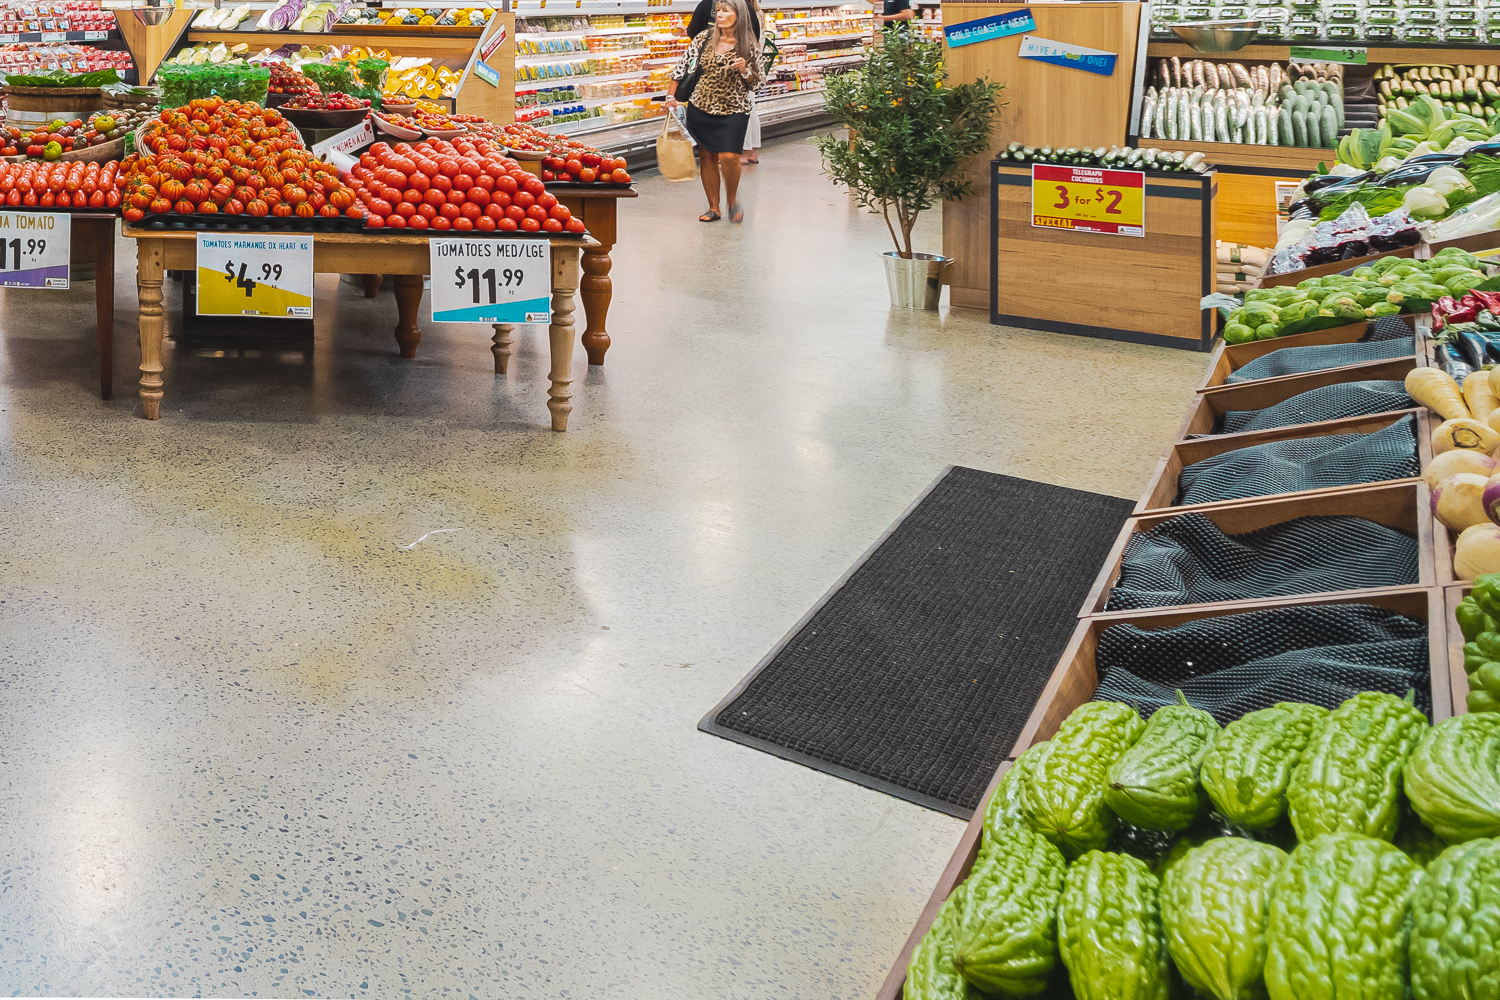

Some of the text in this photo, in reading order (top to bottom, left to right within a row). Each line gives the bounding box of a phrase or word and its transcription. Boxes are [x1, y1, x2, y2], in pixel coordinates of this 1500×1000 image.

[950, 27, 972, 42] GOLD
[971, 22, 999, 37] COAST
[1027, 43, 1049, 56] HAVE
[1052, 48, 1057, 57] A
[1087, 55, 1108, 68] ONE!
[1071, 175, 1104, 184] CUCUMBERS
[1072, 169, 1103, 177] TELEGRAPH
[1053, 185, 1123, 215] 3 for $2
[15, 214, 55, 230] TOMATO
[1034, 216, 1075, 229] SPECIAL
[202, 240, 232, 249] TOMATOES
[233, 241, 267, 250] MARMANDE
[268, 241, 277, 250] OX
[278, 242, 296, 250] HEART
[435, 242, 545, 258] TOMATOES MED/LGE
[224, 260, 283, 297] $4.99
[454, 265, 524, 304] $11.99
